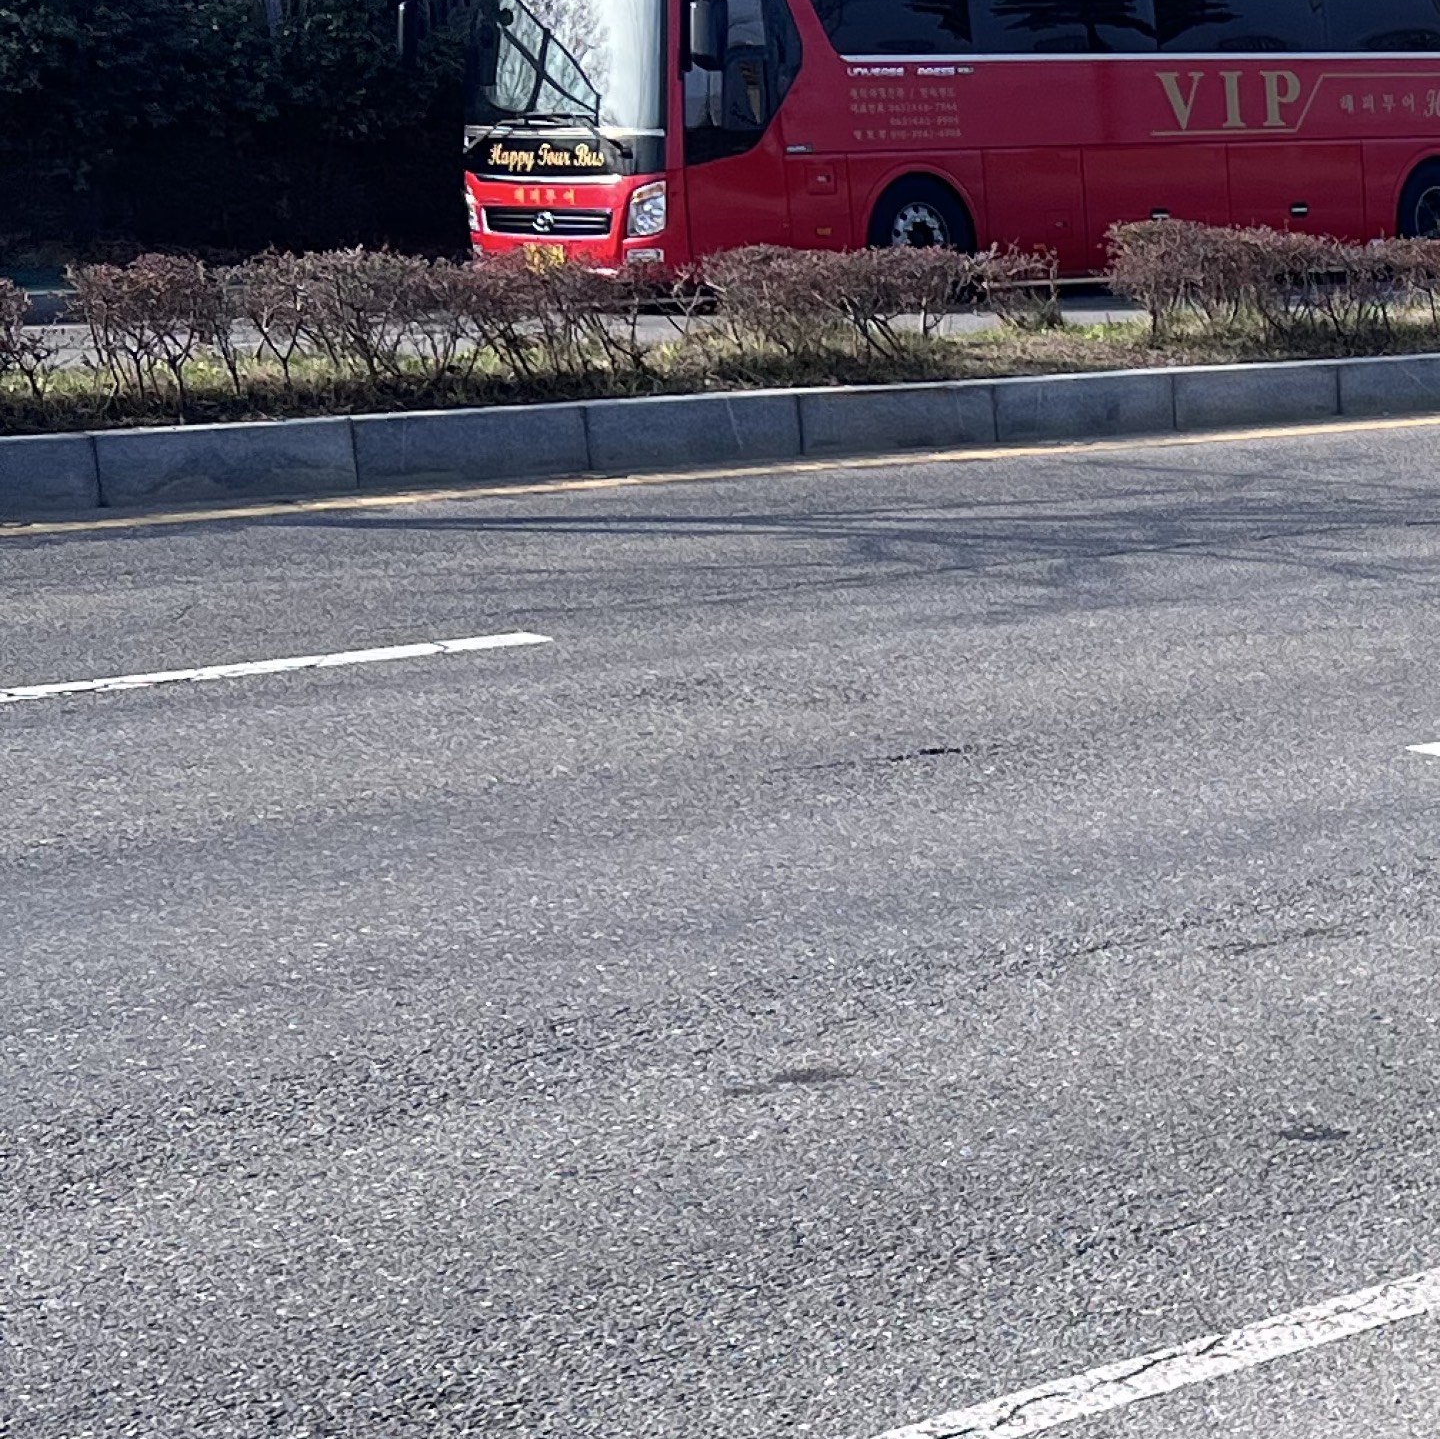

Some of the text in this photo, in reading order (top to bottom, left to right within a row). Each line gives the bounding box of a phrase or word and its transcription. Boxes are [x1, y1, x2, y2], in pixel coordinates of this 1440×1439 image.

[1155, 70, 1300, 130] VIP
[488, 142, 605, 172] Happy Tour Bus
